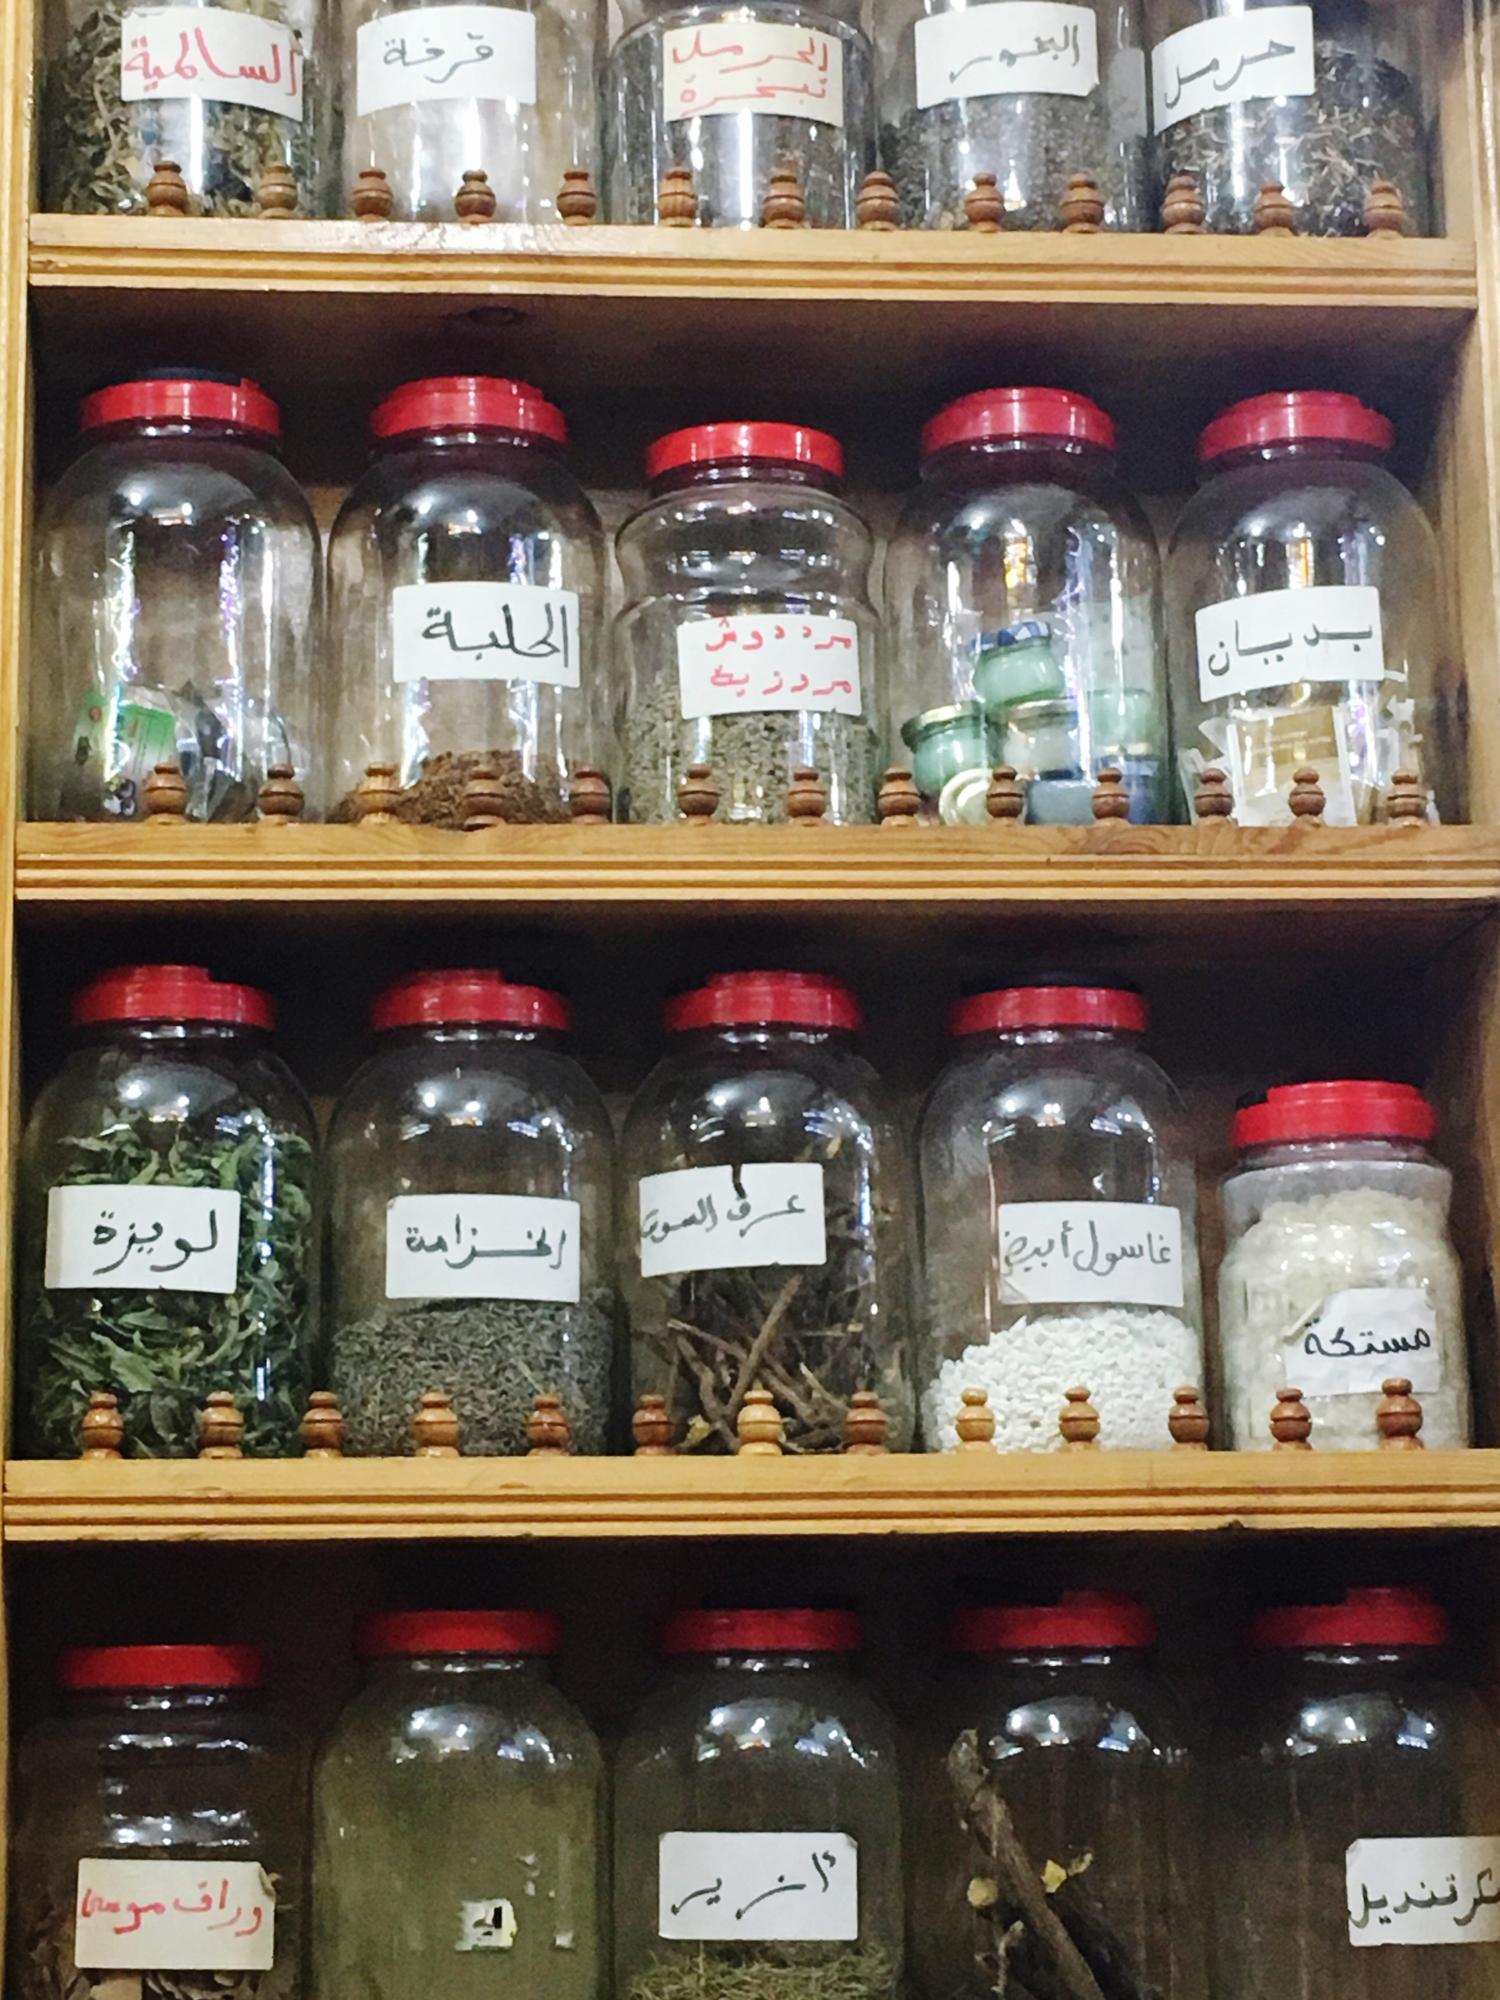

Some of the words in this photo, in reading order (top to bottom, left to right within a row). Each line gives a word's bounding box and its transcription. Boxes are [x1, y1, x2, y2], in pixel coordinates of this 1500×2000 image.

[383, 32, 494, 84] قرفة
[1164, 40, 1296, 109] حرمل
[422, 602, 568, 668] الحلبة
[1208, 619, 1373, 677] بديان
[92, 1208, 218, 1276] لويزة
[405, 1213, 566, 1270] الخزامة
[1072, 1220, 1172, 1277] غاسول
